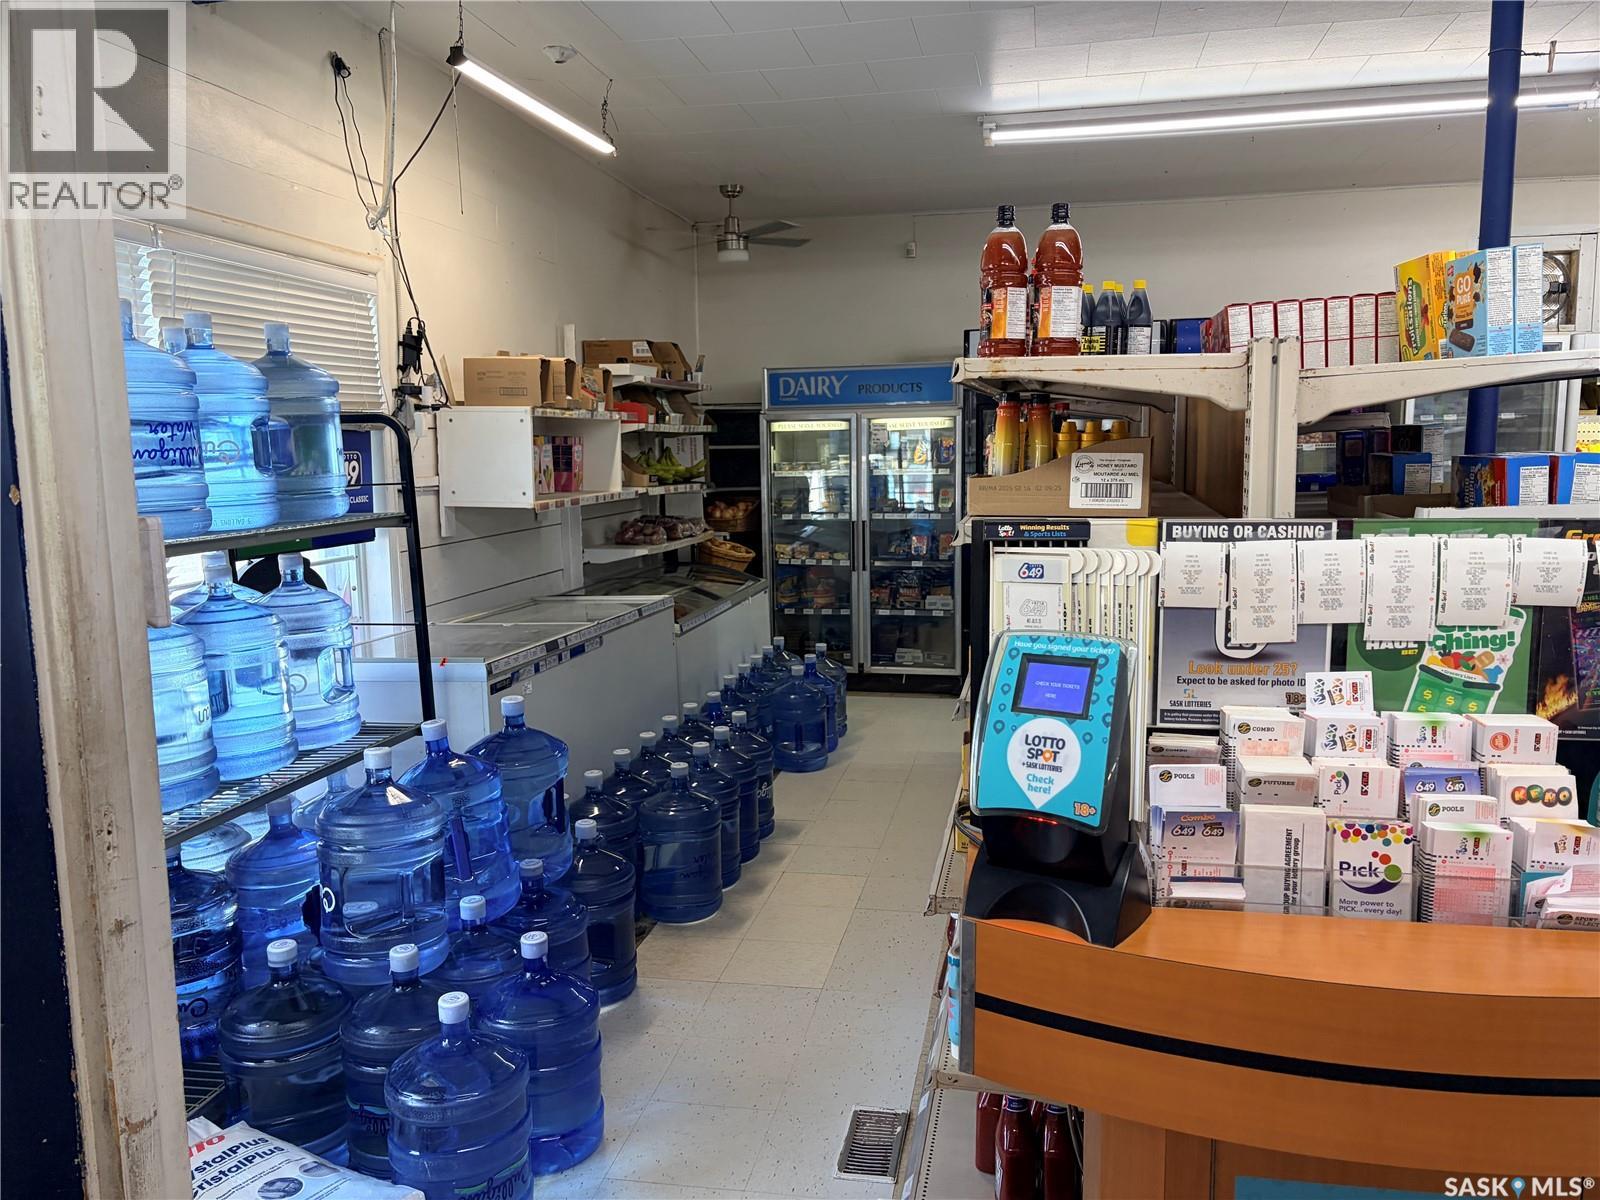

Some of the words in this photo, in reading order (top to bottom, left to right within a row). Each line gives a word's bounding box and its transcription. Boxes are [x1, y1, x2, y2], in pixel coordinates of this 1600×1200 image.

[1456, 275, 1471, 294] GO
[1456, 293, 1472, 305] PURE
[779, 375, 848, 398] DAIRY
[858, 383, 922, 395] PRODUCTS
[144, 421, 195, 442] Water
[1172, 525, 1229, 539] BUYING
[1233, 525, 1254, 539] OR
[1257, 525, 1325, 539] CASHING
[1048, 643, 1071, 652] signed
[1072, 645, 1089, 653] your
[1090, 645, 1115, 655] ticket?
[1432, 631, 1516, 652] Ching!
[1188, 660, 1223, 675] Look
[1227, 661, 1270, 676] under
[1272, 662, 1297, 676] 25?
[1177, 676, 1205, 686] Expect
[1207, 677, 1216, 685] to
[1217, 676, 1228, 685] be
[1230, 676, 1255, 686] asked
[1257, 677, 1270, 686] for
[1271, 678, 1295, 688] photo
[1297, 679, 1306, 687] ID
[1169, 700, 1183, 708] SASK
[1184, 700, 1212, 709] LOTTERIES
[1024, 734, 1066, 750] LOTTO
[1026, 762, 1038, 770] SASK
[1038, 763, 1063, 773] LOTTERIES
[1026, 773, 1055, 785] Check
[1360, 771, 1369, 796] EXTRA
[1027, 783, 1052, 795] here!
[1333, 779, 1342, 796] Pick
[1511, 784, 1573, 808] KENO
[1073, 801, 1097, 817] 18+
[1181, 814, 1216, 823] Combo
[1285, 828, 1293, 866] AGREEMENT
[1293, 838, 1301, 857] group
[1292, 858, 1300, 879] lottery
[1339, 861, 1380, 878] Pick
[1364, 907, 1384, 915] every
[1386, 908, 1402, 916] day!
[190, 1135, 270, 1182] stalPlus
